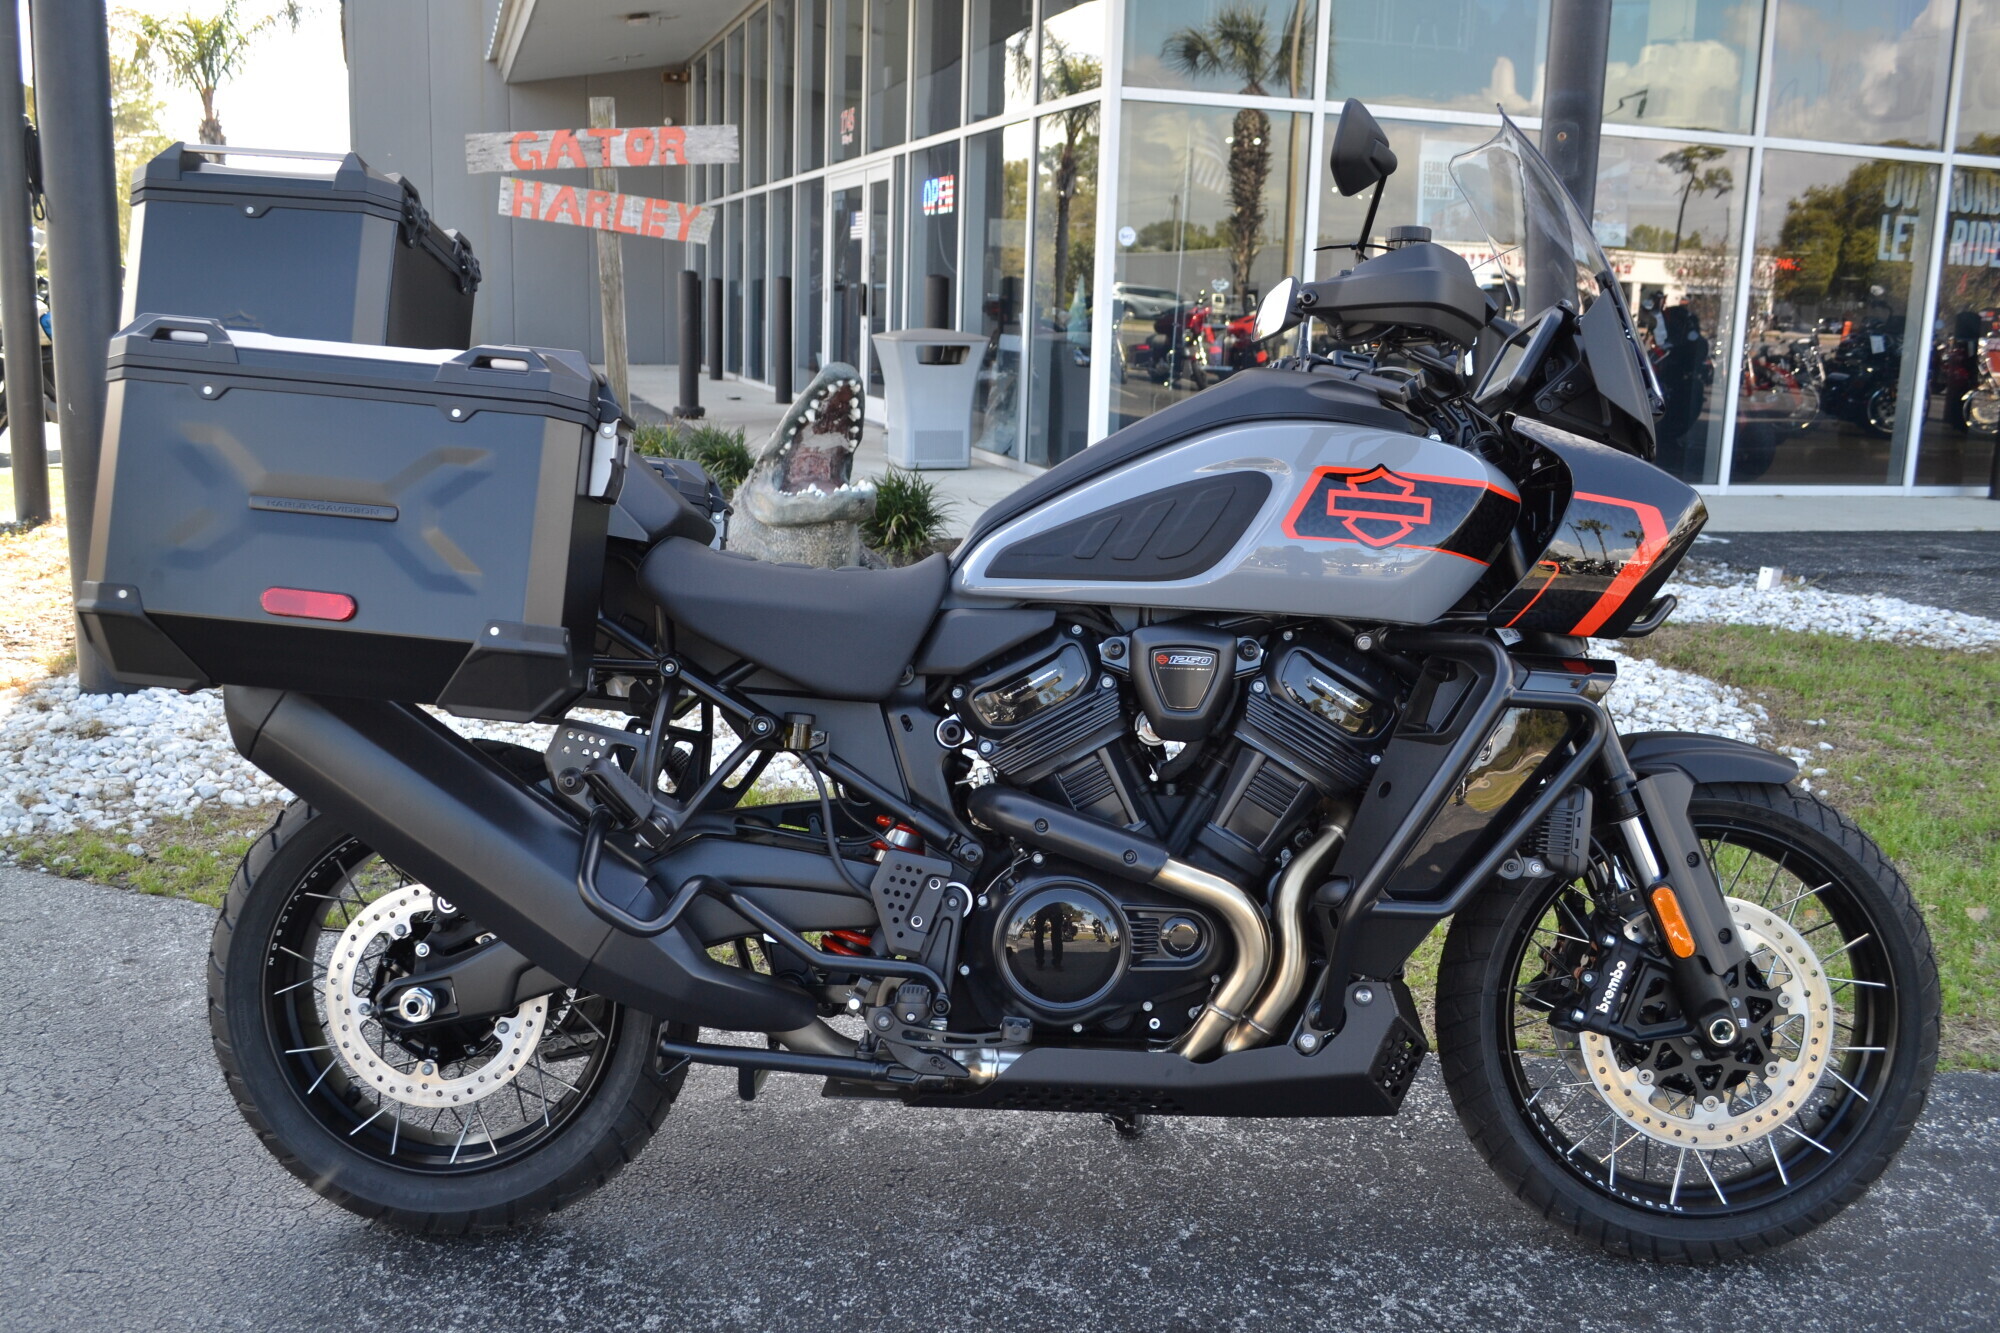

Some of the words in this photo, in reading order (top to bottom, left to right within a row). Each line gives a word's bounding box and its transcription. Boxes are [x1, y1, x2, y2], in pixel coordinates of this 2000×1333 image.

[509, 126, 688, 170] GATOR
[511, 179, 702, 241] HARLEY
[923, 175, 954, 216] OPEN
[1169, 655, 1212, 665] 1250
[1596, 961, 1627, 1013] brembo
